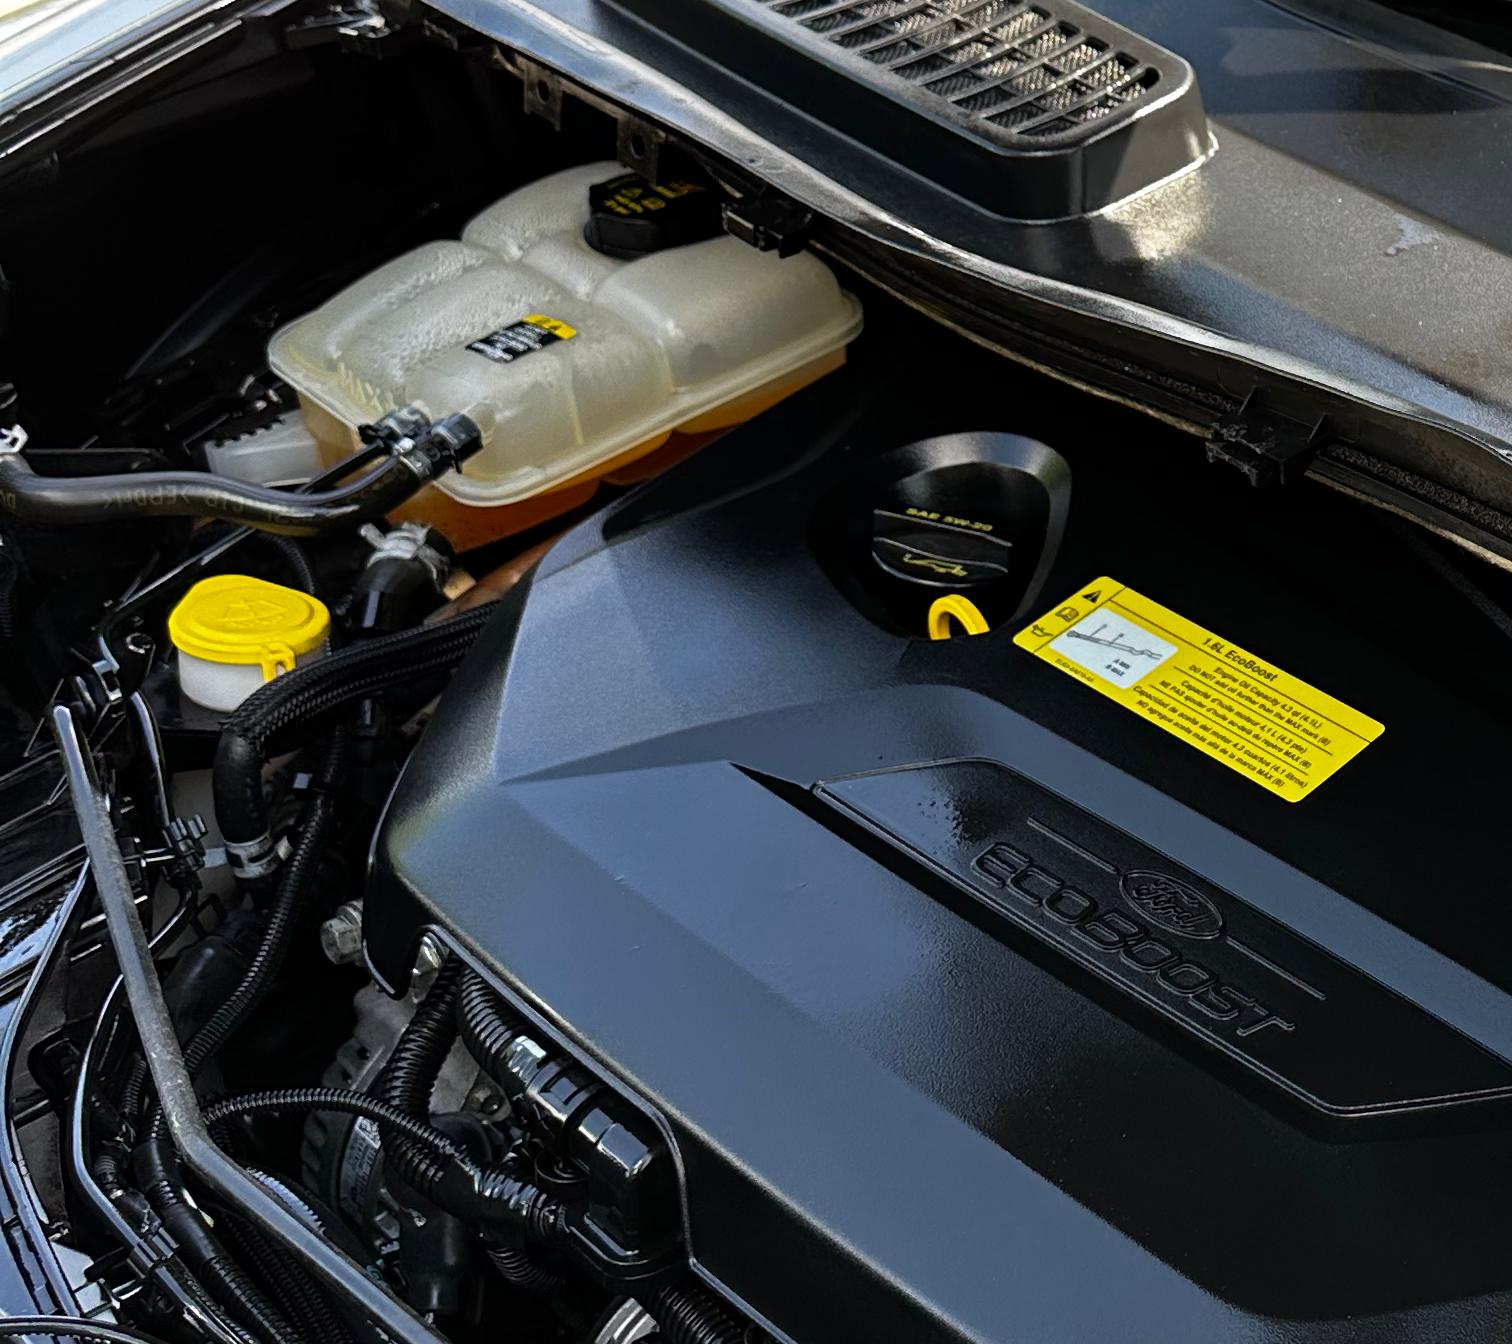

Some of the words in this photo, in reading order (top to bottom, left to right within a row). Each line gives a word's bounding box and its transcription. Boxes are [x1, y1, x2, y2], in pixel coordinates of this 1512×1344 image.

[1202, 637, 1225, 654] 1.6L
[1224, 649, 1278, 681] EcoBoost
[1214, 666, 1239, 683] Engine
[1249, 686, 1281, 706] Capacity
[1133, 877, 1210, 931] Ford
[970, 842, 1296, 1037] ECOBOOST
